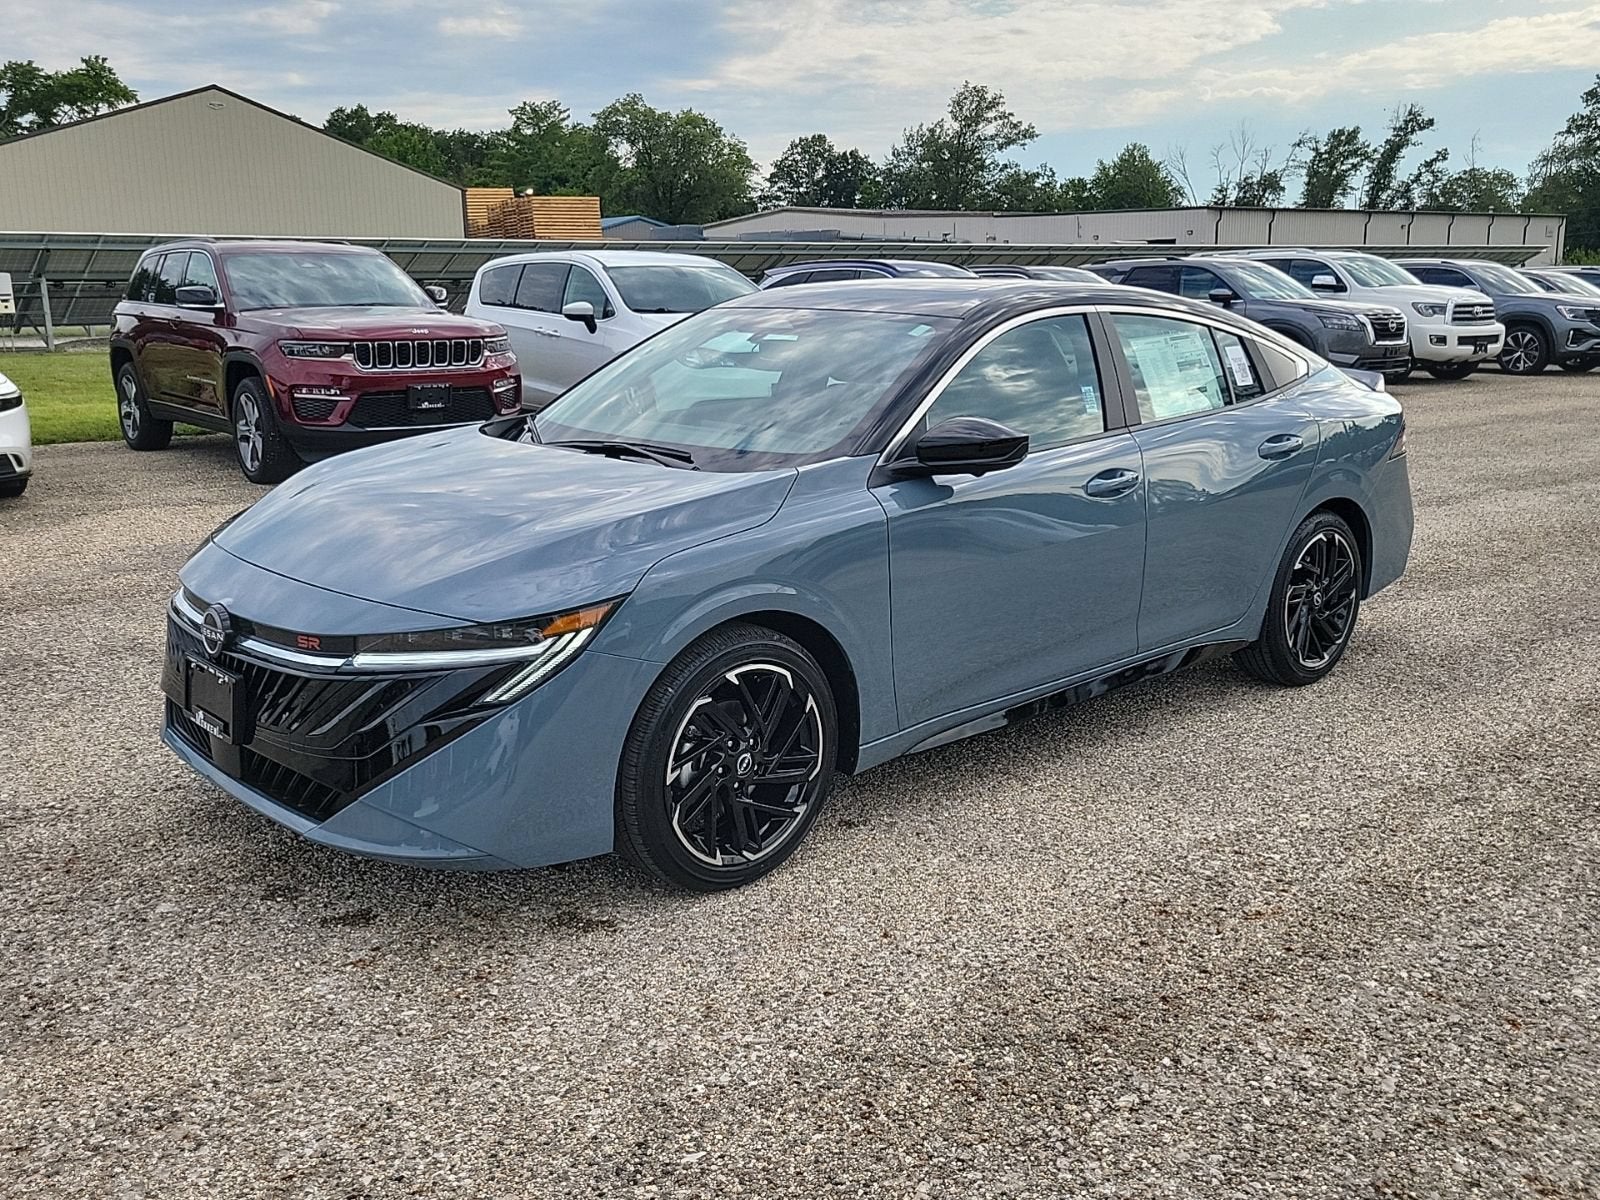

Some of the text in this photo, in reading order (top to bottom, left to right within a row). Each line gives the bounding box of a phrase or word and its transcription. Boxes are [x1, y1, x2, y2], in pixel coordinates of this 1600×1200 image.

[411, 327, 430, 335] Jeep
[199, 625, 225, 642] ISSAN
[297, 635, 321, 651] SR
